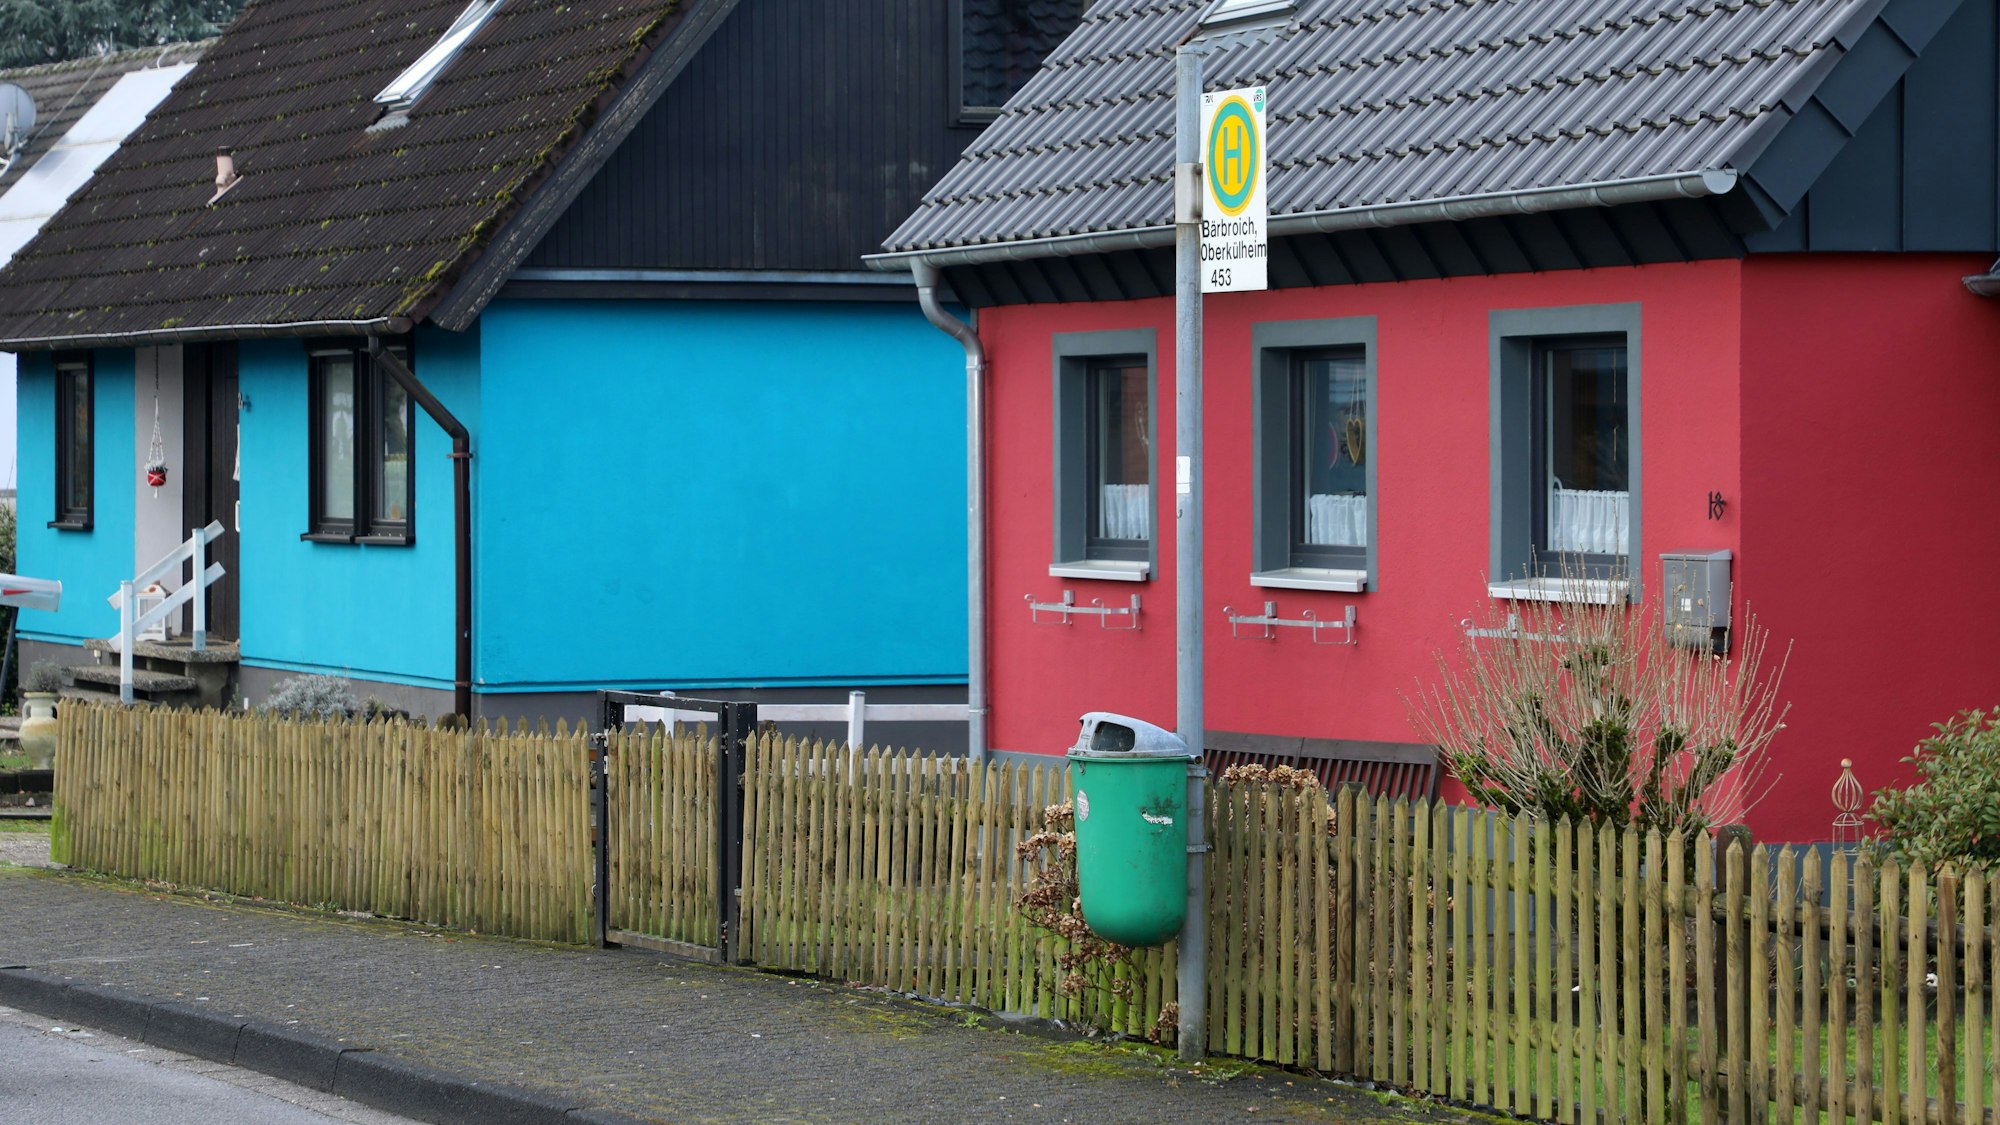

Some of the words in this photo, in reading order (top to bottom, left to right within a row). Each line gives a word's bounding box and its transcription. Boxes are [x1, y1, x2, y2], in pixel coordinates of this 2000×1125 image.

[1223, 125, 1242, 185] H
[1202, 217, 1257, 238] Bärbroich,
[1201, 239, 1267, 261] Oberkülheim
[1211, 268, 1232, 287] 453
